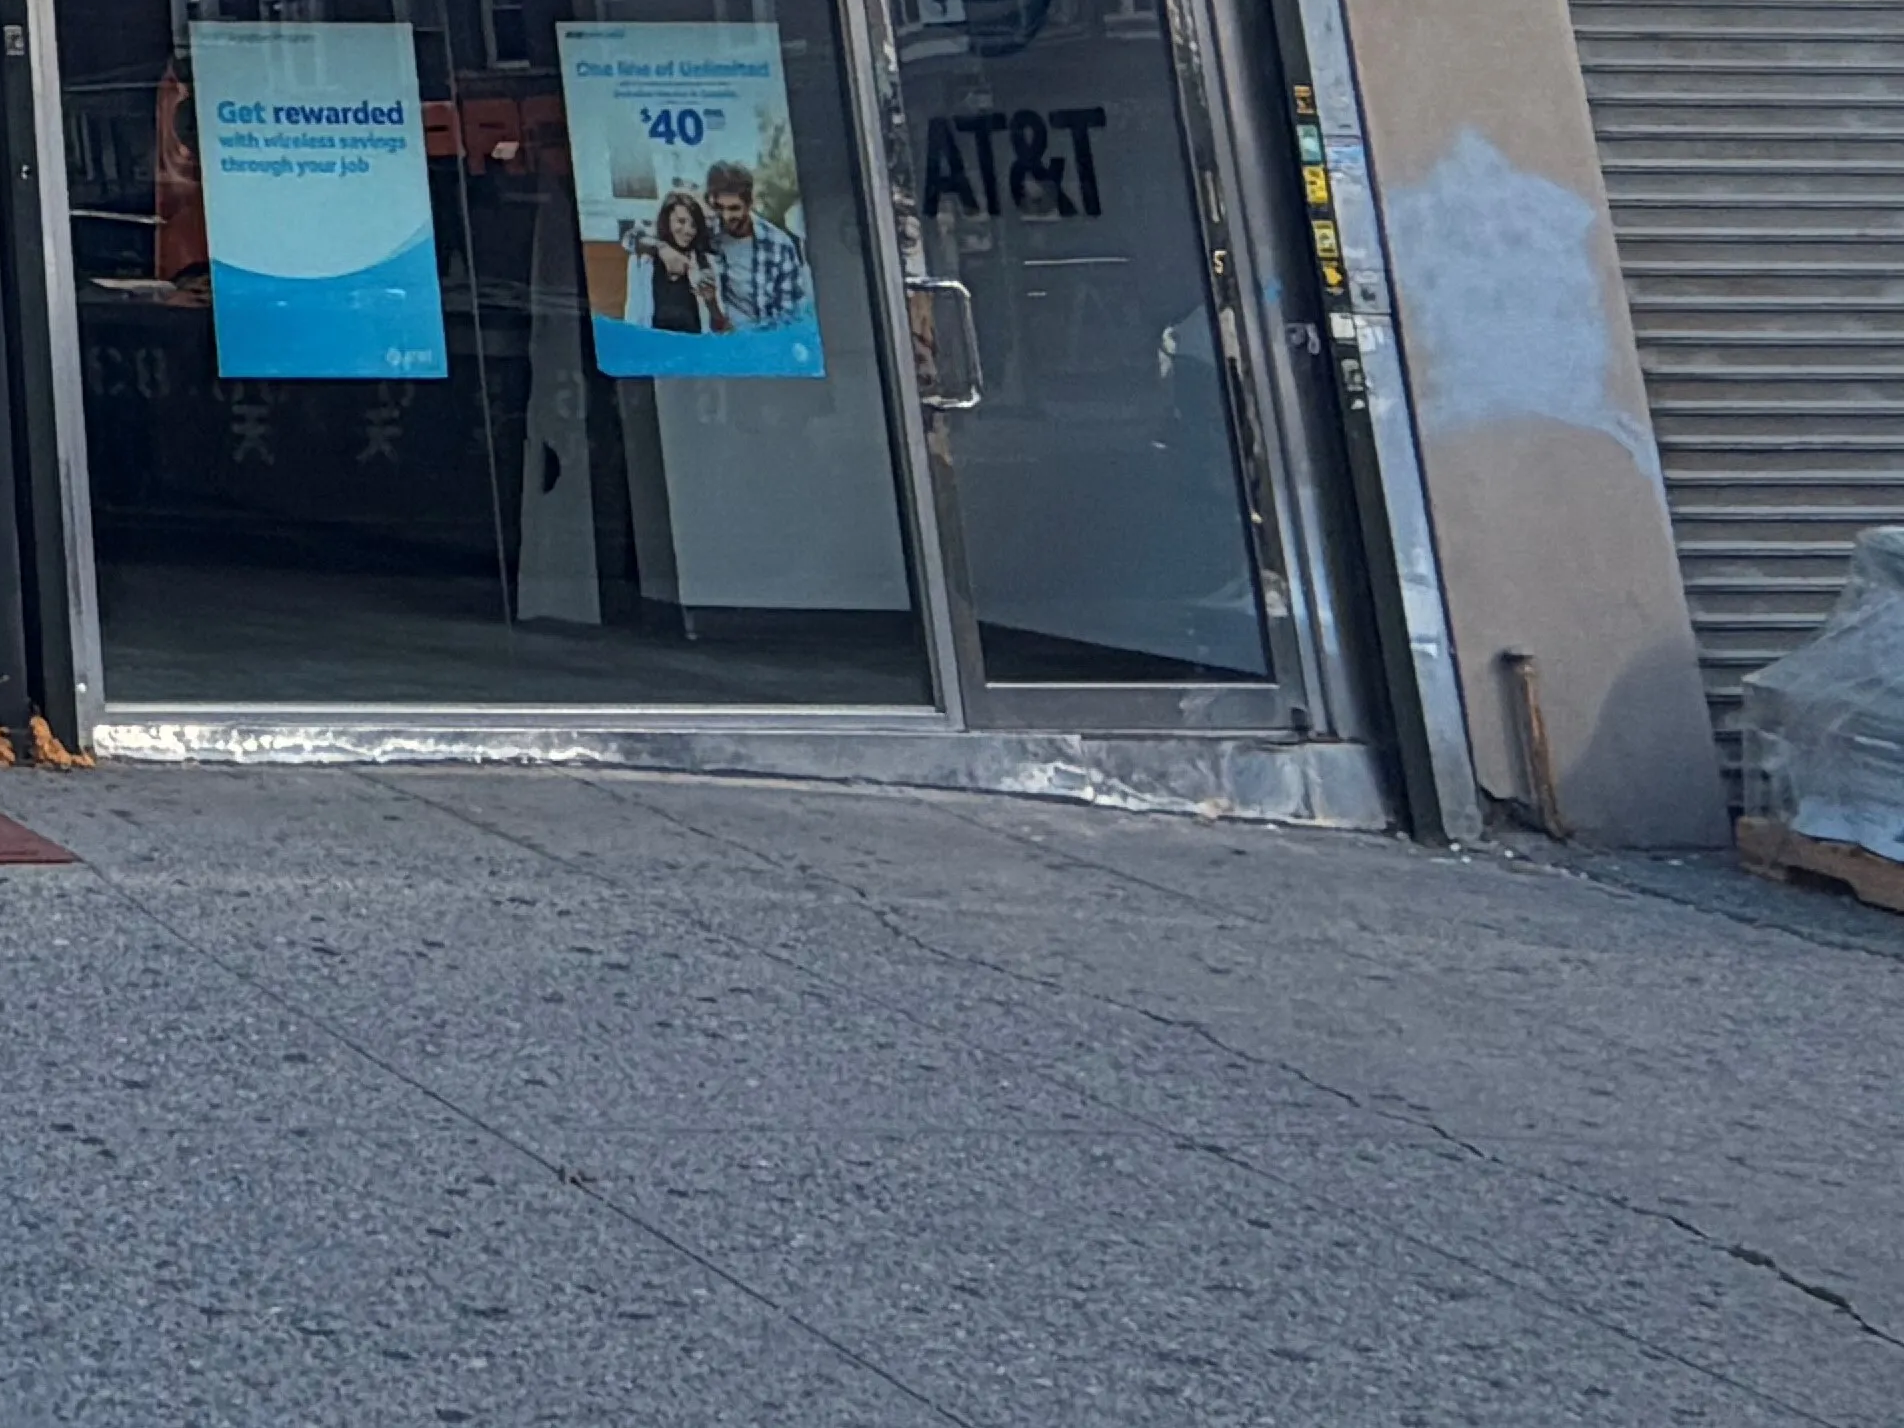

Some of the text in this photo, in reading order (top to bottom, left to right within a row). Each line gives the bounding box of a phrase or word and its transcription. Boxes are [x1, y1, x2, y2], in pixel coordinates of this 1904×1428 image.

[217, 100, 404, 125] Get rewarded
[640, 107, 704, 146] $40
[219, 132, 260, 149] with
[339, 132, 407, 153] savings
[220, 157, 370, 177] through your job
[923, 106, 1106, 218] AT&T
